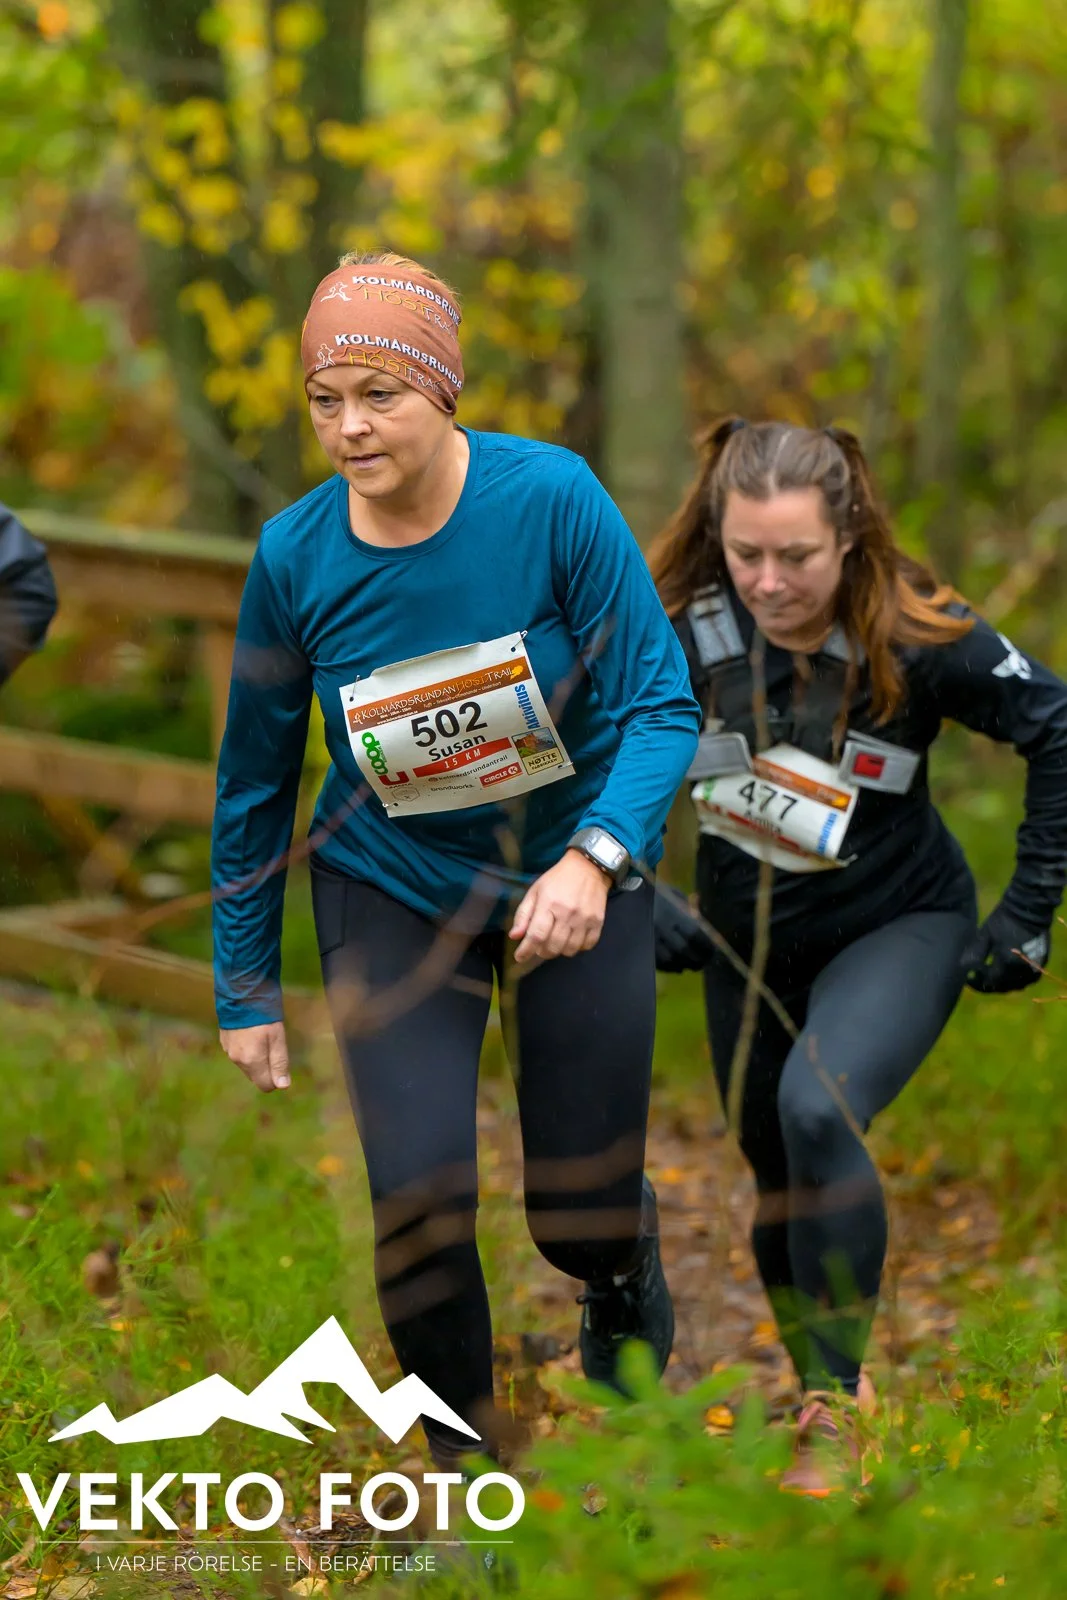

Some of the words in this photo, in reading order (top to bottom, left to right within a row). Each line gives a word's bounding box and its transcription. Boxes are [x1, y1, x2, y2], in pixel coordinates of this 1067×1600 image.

[352, 276, 461, 325] KOLMÅRDSRUN
[410, 700, 488, 749] 502
[514, 683, 540, 729] Aktivitus
[361, 732, 388, 776] coop
[428, 734, 487, 762] Susan
[484, 770, 508, 784] CIRCLE
[738, 780, 798, 820] 477
